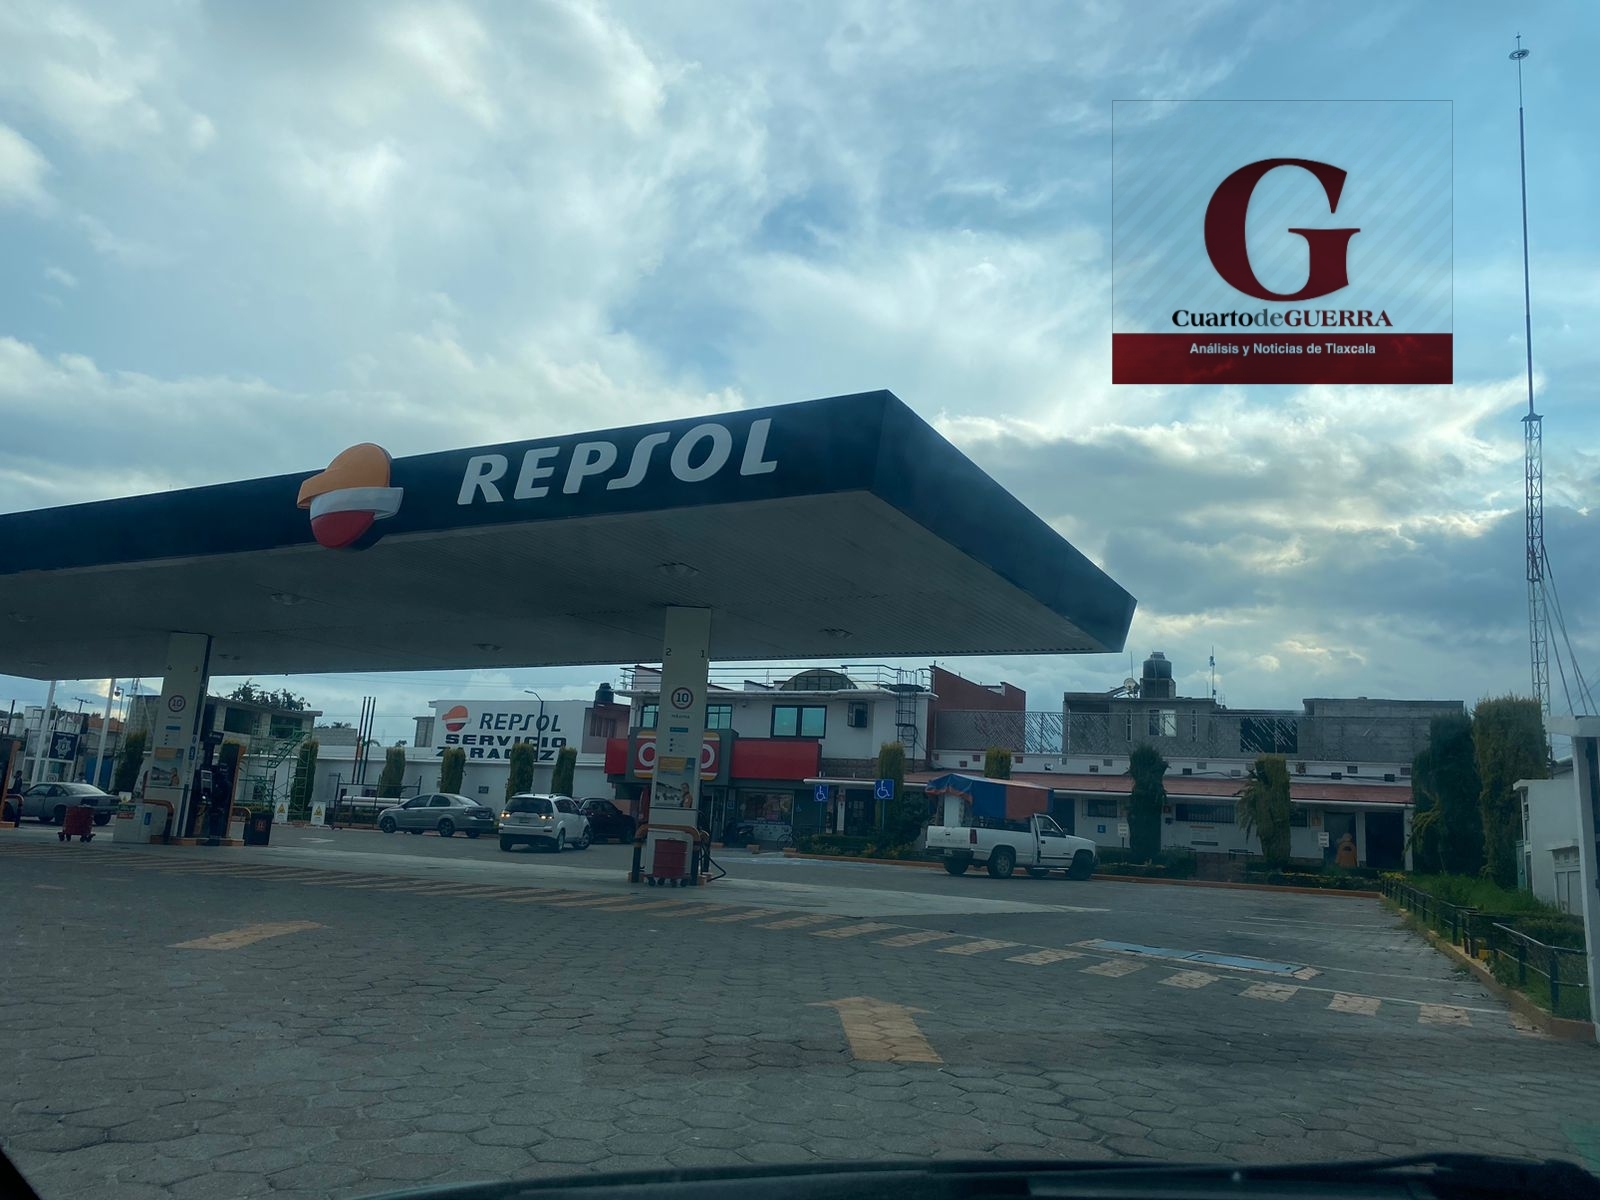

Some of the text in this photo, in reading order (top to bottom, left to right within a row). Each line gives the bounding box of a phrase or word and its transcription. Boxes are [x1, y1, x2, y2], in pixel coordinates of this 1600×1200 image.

[456, 418, 779, 506] REPSOL
[666, 647, 672, 656] 2
[676, 692, 689, 703] 10
[479, 713, 561, 732] REPSOL
[445, 734, 567, 748] SERVICIO
